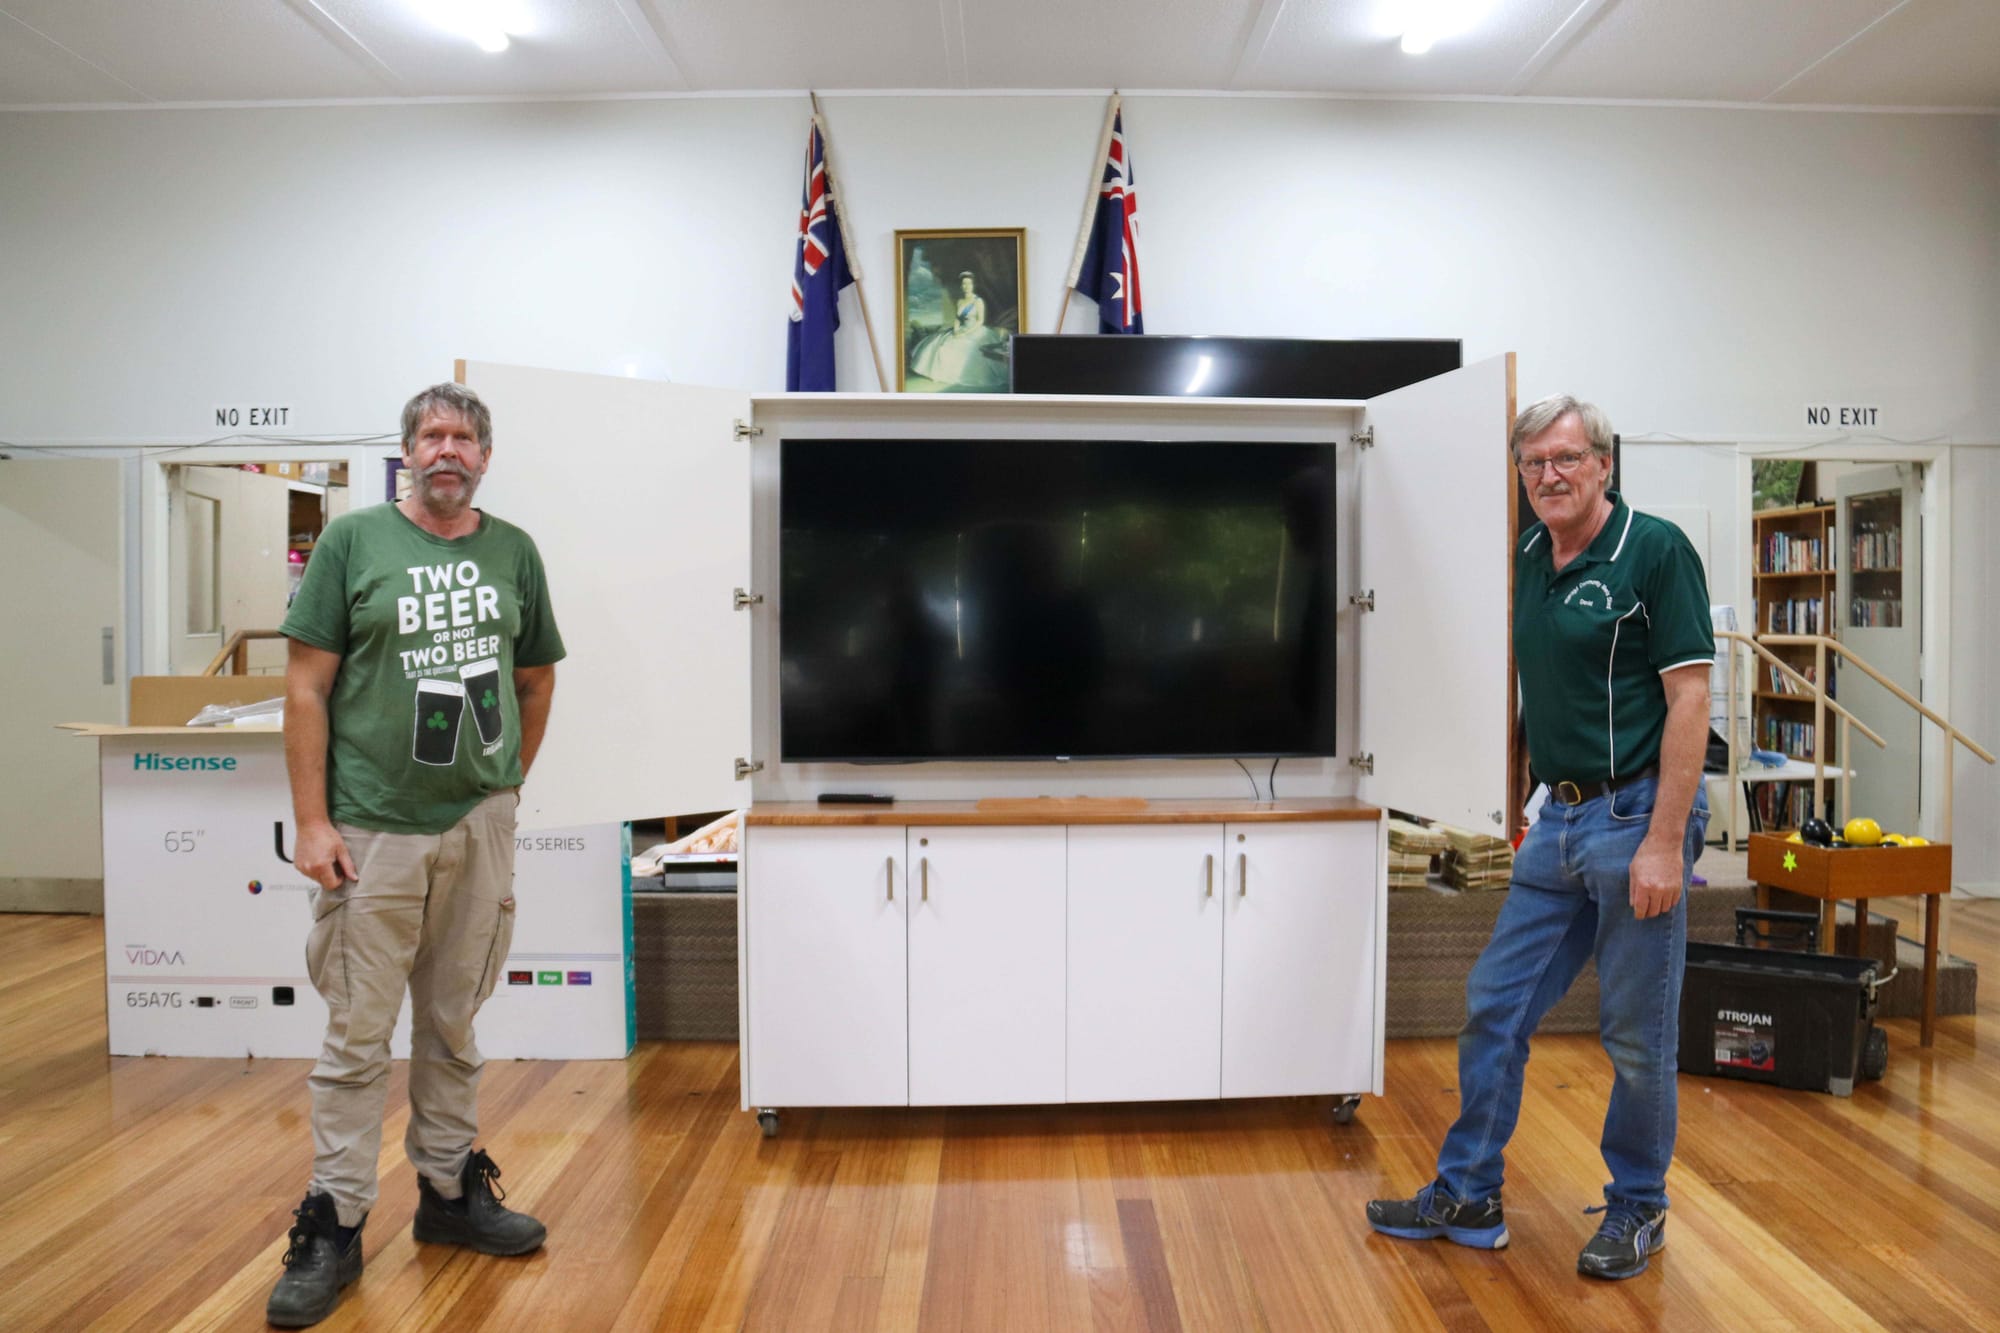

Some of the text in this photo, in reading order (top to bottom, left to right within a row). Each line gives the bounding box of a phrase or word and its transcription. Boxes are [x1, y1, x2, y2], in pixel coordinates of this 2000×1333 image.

[216, 407, 289, 426] NO EXIT
[1807, 407, 1878, 426] NO EXIT
[407, 560, 480, 594] TWO
[397, 585, 502, 635] BEER
[433, 626, 476, 644] OR NOT
[399, 635, 501, 671] TWO BEER
[133, 752, 237, 771] Hisense
[535, 838, 585, 851] SERIES
[126, 991, 182, 1008] 65A7G
[232, 999, 255, 1007] FRONT
